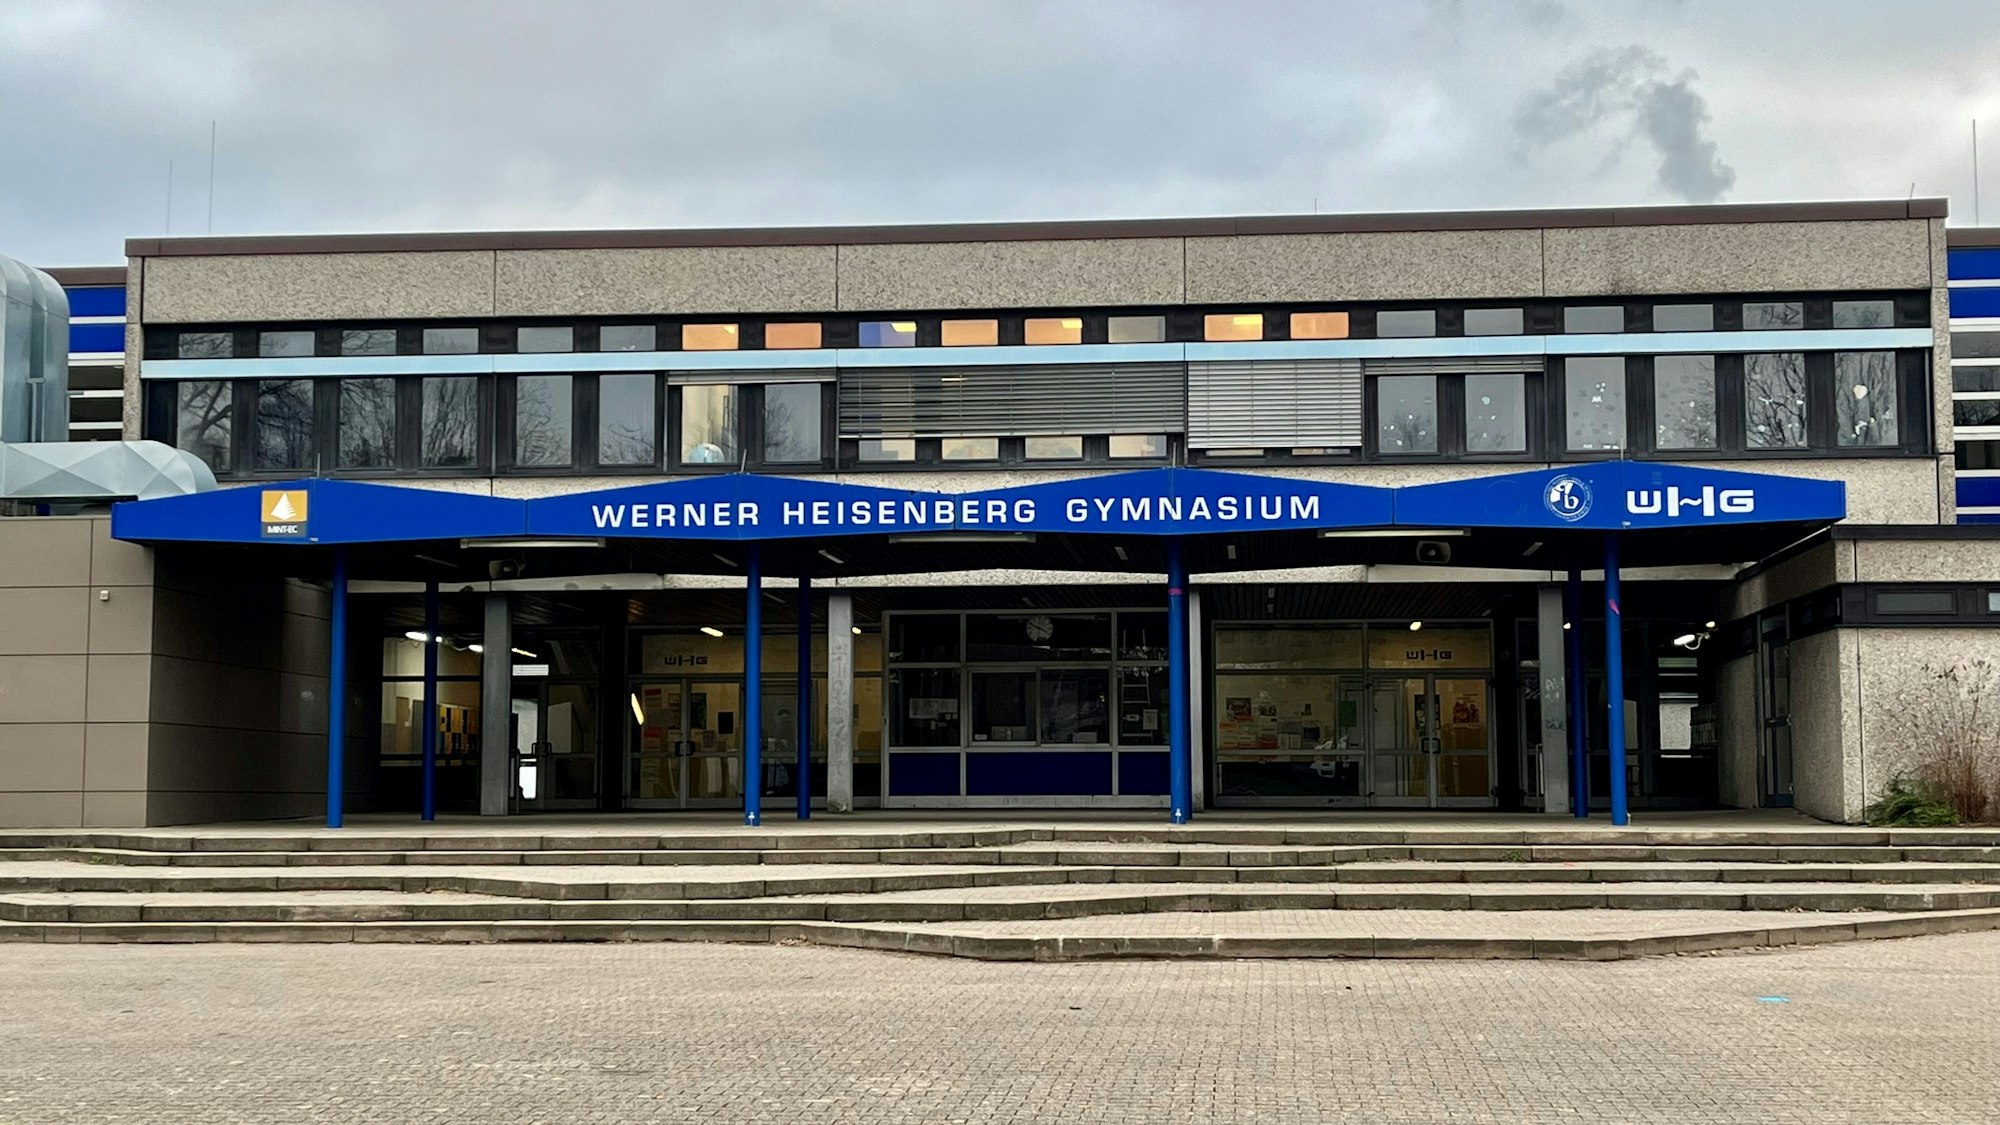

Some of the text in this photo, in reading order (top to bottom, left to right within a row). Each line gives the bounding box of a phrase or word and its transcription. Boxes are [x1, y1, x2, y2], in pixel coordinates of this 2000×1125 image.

[592, 496, 1319, 527] WERNER HEISENBERG GYMNASIUM
[1627, 486, 1755, 516] WHG
